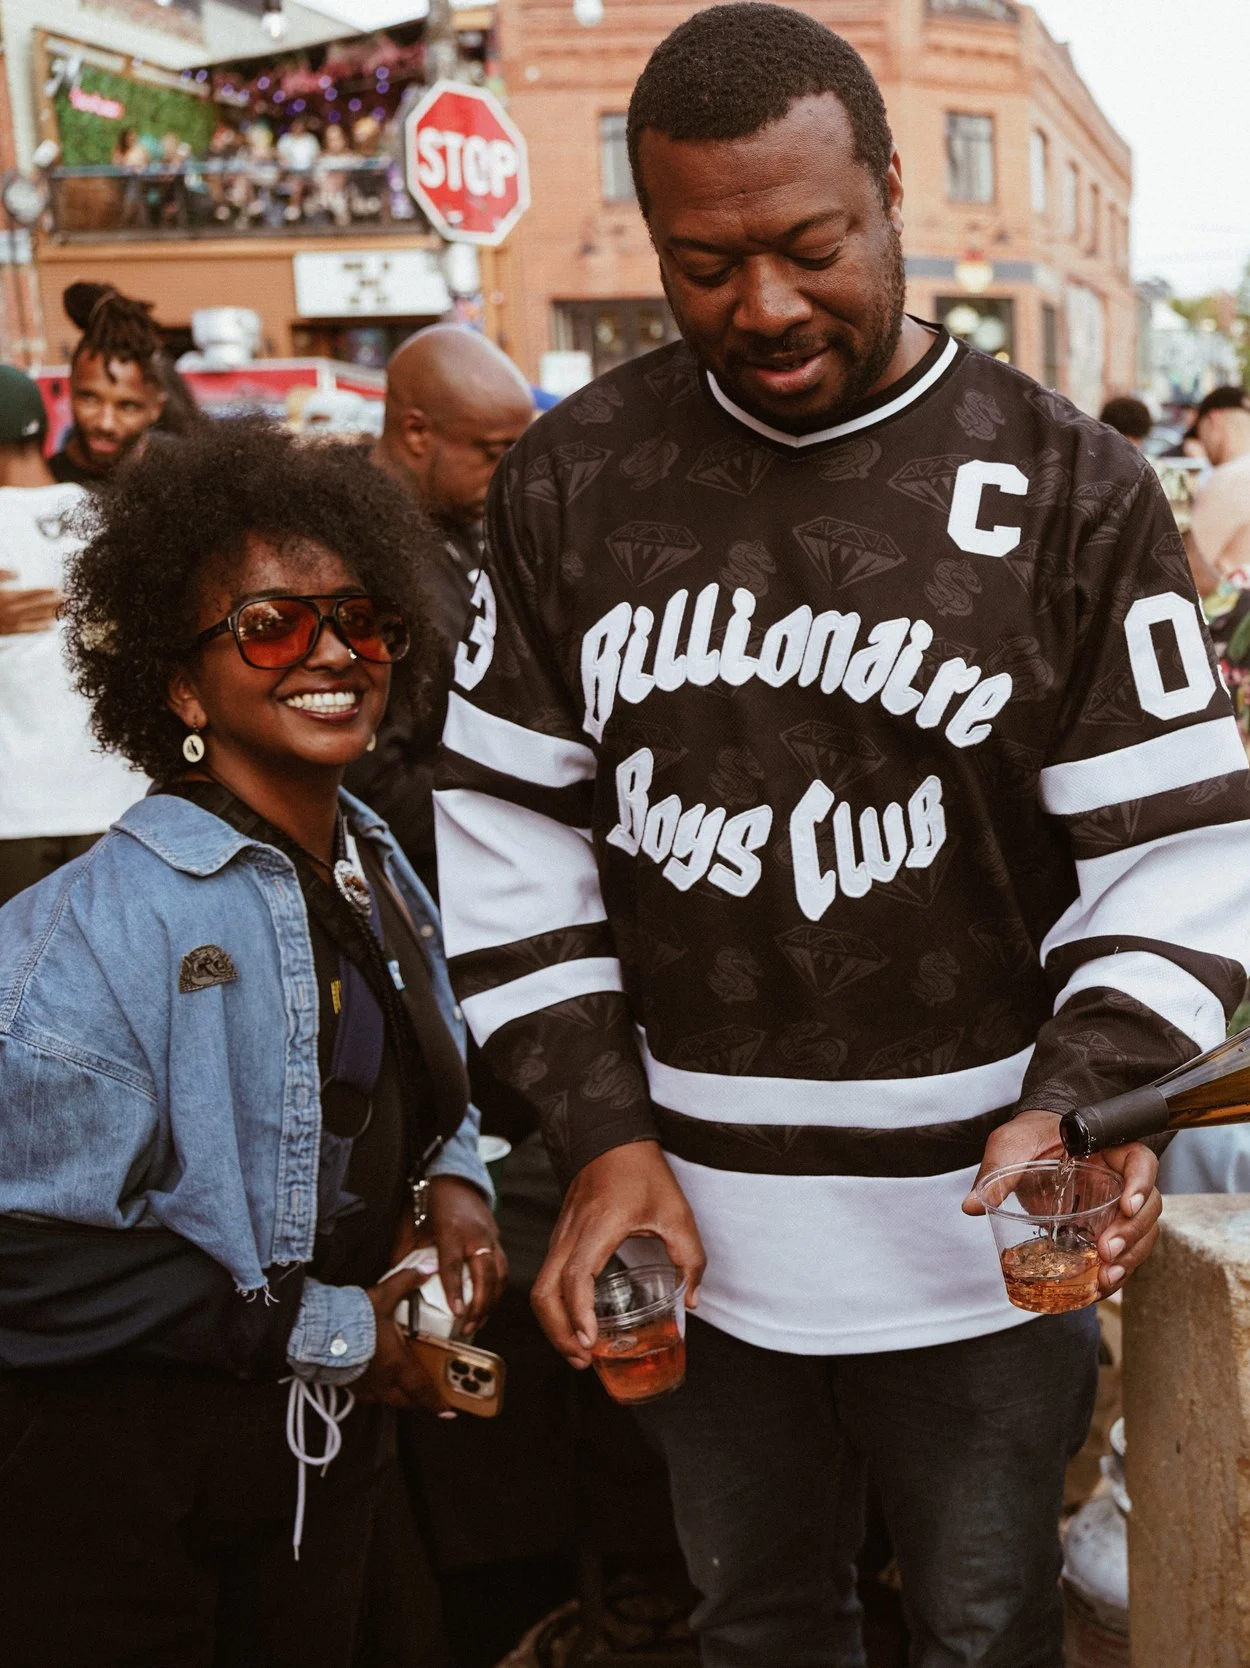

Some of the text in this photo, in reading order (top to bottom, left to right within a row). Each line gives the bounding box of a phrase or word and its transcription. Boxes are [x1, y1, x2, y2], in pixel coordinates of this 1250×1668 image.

[420, 127, 518, 198] STOP
[947, 459, 1029, 558] C
[581, 583, 1012, 748] Billionaire
[1123, 591, 1231, 721] 0
[606, 747, 773, 897] Boys
